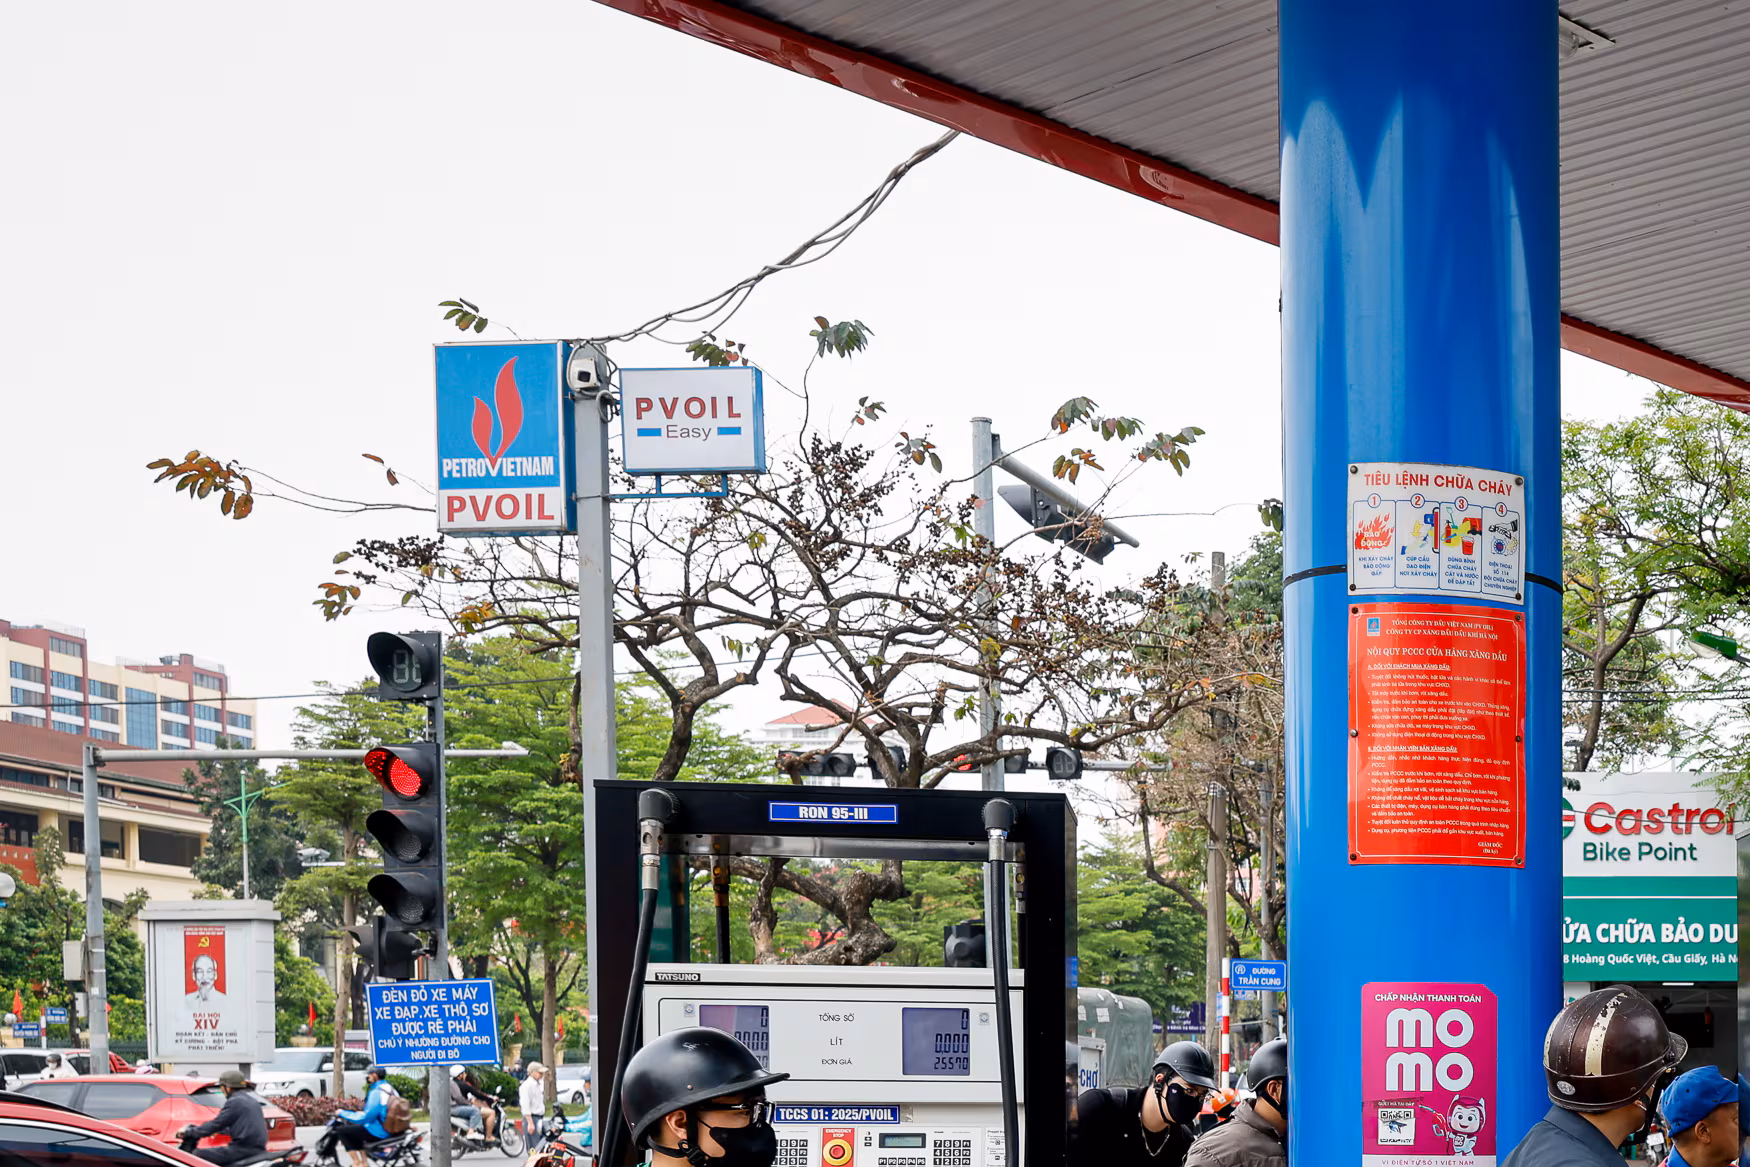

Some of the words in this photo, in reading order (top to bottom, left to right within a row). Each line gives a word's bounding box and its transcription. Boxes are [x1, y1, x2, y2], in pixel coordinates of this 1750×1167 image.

[635, 396, 741, 420] PVOIL
[666, 424, 711, 441] Easy
[442, 455, 554, 478] PETROVIETNAM
[1364, 470, 1390, 485] TIÊU
[1395, 471, 1429, 489] LỆNH
[1434, 474, 1473, 490] CHỮA
[1478, 477, 1513, 496] CHÁY
[1372, 495, 1377, 506] 1
[1415, 496, 1420, 505] 2
[1459, 499, 1465, 509] 3
[447, 494, 554, 522] PVOIL
[1499, 505, 1504, 514] 4
[1367, 646, 1381, 657] NỘI
[1383, 648, 1400, 656] QUY
[1402, 648, 1424, 656] PCCC
[1426, 646, 1444, 656] CỬA
[1445, 647, 1468, 657] HÀNG
[1469, 650, 1490, 659] XĂNG
[1492, 650, 1507, 661] DẦU
[799, 806, 827, 819] RON
[832, 808, 868, 819] 95-III
[1584, 801, 1735, 835] Castrol
[1583, 841, 1631, 862] Bike
[1638, 842, 1697, 861] Point
[1596, 918, 1656, 944] CHỮA
[1661, 916, 1704, 944] BẢO
[1571, 954, 1606, 966] Hoàng
[1608, 953, 1634, 964] Quốc
[1636, 952, 1660, 966] Việt,
[1661, 953, 1685, 965] Cầu
[1687, 951, 1708, 966] Giấy,
[1712, 954, 1727, 964] Hà
[1252, 966, 1276, 975] ĐƯỜNG
[656, 973, 699, 982] TATSUNO
[1238, 973, 1259, 985] TRẦN
[382, 987, 407, 1003] ĐÈN
[410, 985, 428, 1002] ĐỎ
[431, 988, 448, 1001] XE
[452, 984, 478, 1000] MÁY
[1375, 992, 1398, 1001] CHẤP
[1400, 993, 1425, 1003] NHẬN
[1427, 994, 1456, 1002] THANH
[1458, 993, 1482, 1003] TOÁN
[375, 1007, 391, 1020] XE
[442, 1002, 468, 1018] THÔ
[472, 1002, 489, 1016] SƠ
[818, 1013, 840, 1022] TỔNG
[843, 1013, 855, 1022] SỐ
[194, 1019, 219, 1030] XIV
[392, 1021, 424, 1036] ĐƯỢC
[428, 1018, 444, 1034] RẼ
[448, 1016, 476, 1033] PHẢI
[378, 1037, 396, 1049] CHÚ
[397, 1038, 402, 1047] Ý
[406, 1036, 439, 1047] NHƯỜNG
[441, 1034, 470, 1046] ĐƯỜNG
[473, 1036, 490, 1045] CHO
[830, 1037, 843, 1046] LÍT
[411, 1048, 436, 1060] NGƯỜI
[438, 1050, 446, 1059] ĐI
[837, 1057, 852, 1065] GIÁ
[780, 1109, 808, 1120] TCCS
[811, 1109, 829, 1121] 01:
[832, 1109, 894, 1121] 2025/PVOIL
